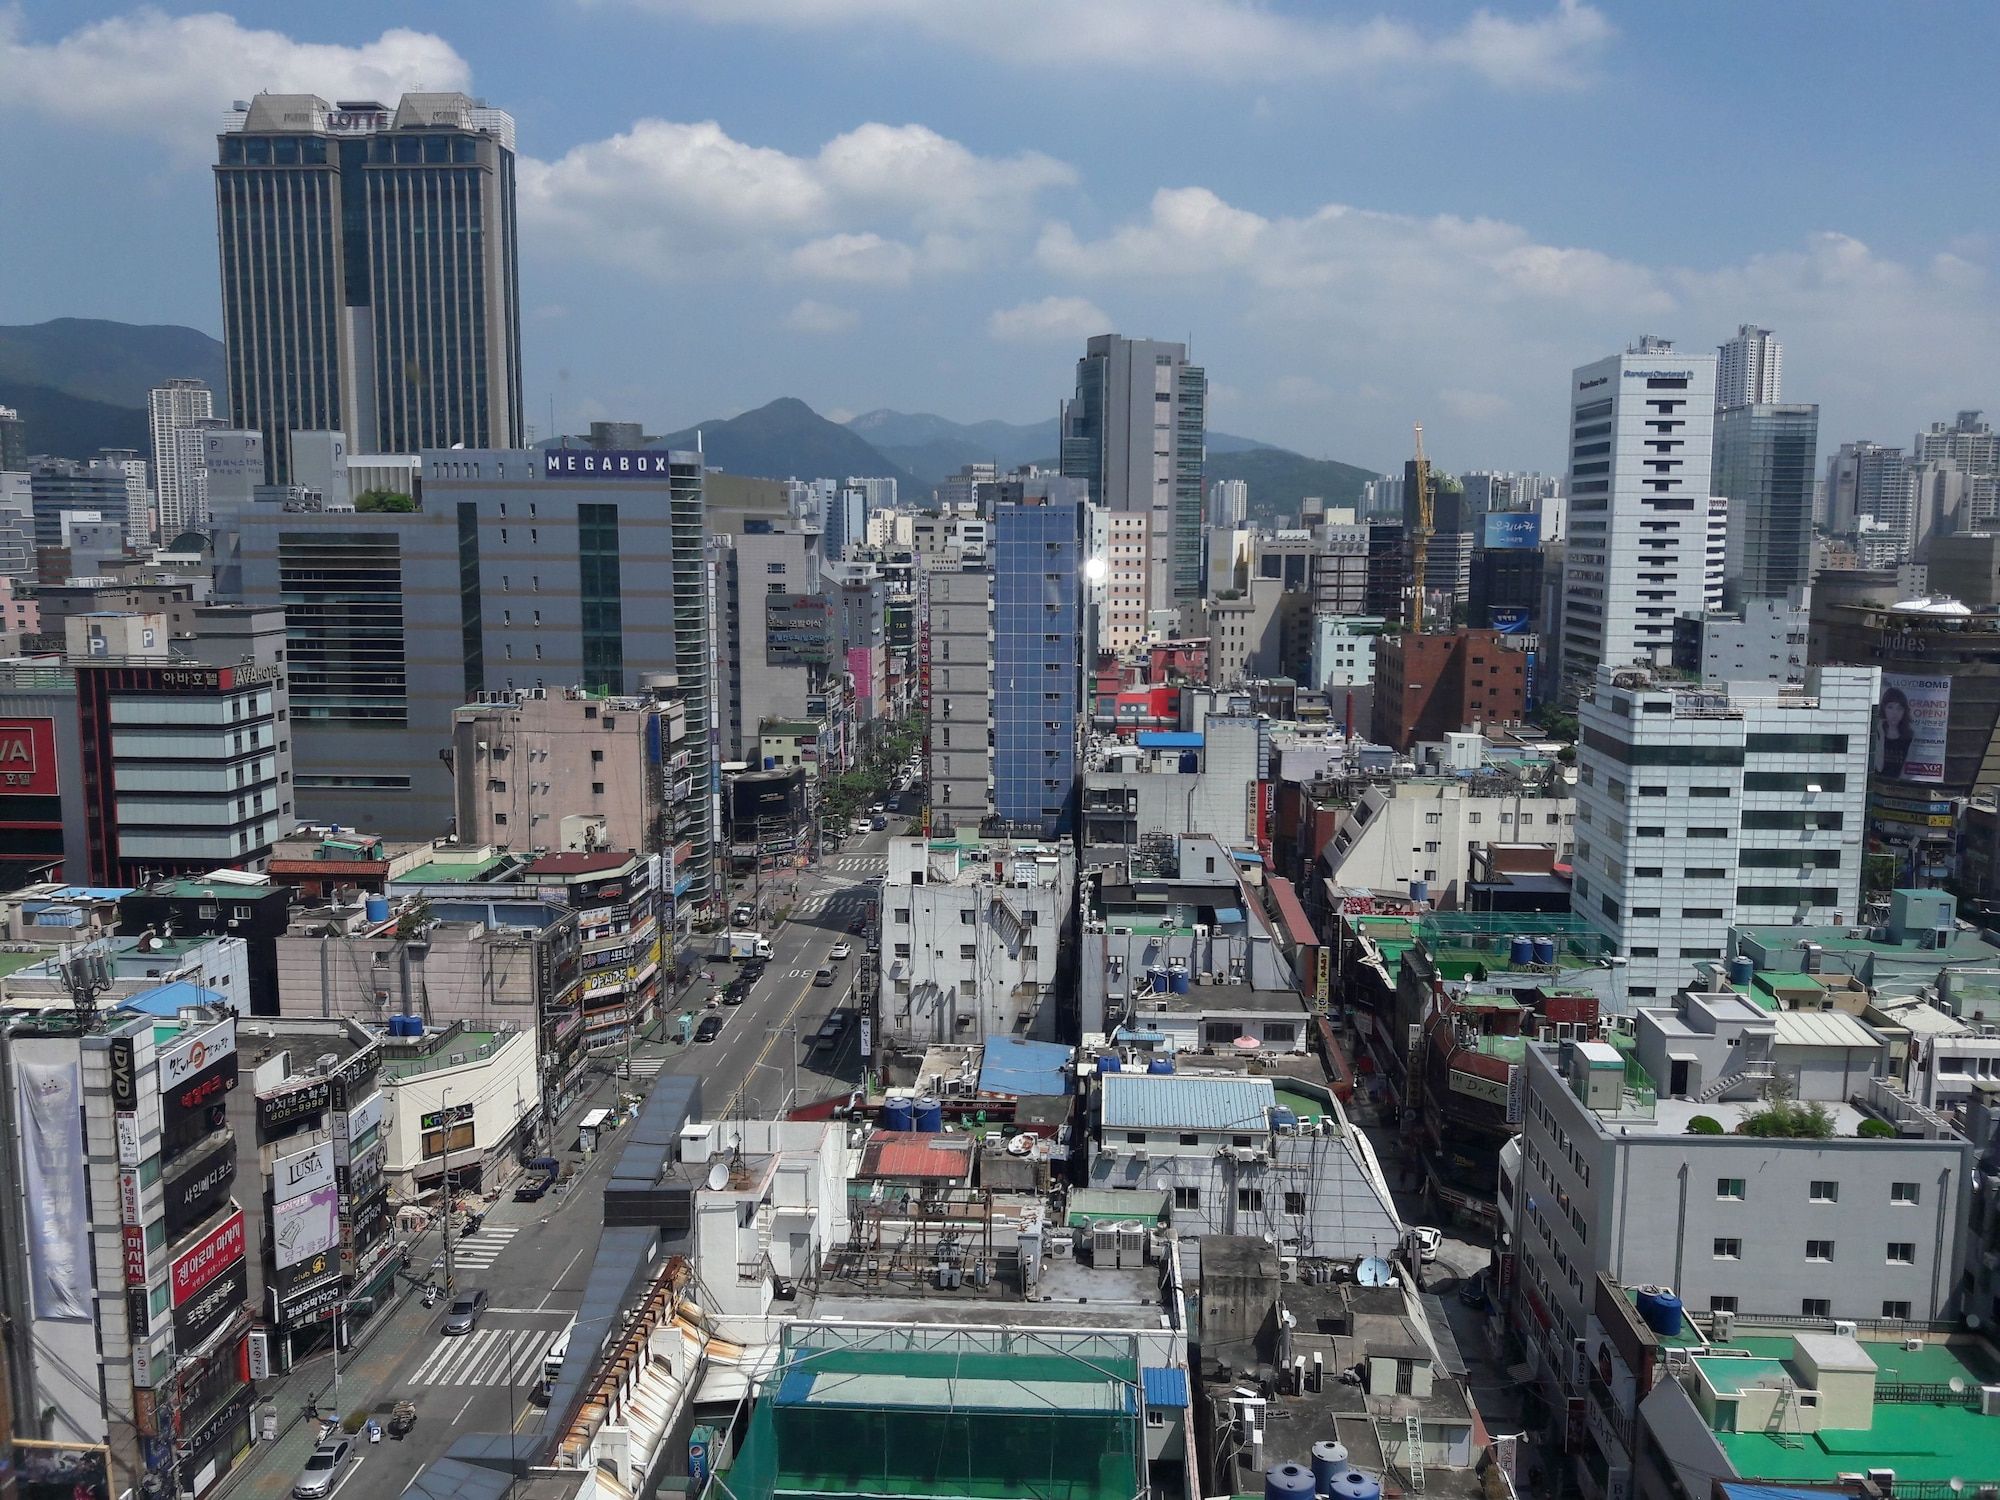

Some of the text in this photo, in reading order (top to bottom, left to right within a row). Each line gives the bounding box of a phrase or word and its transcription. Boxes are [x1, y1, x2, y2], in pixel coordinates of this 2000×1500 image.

[327, 113, 388, 130] LOTTE
[335, 443, 342, 461] P
[547, 456, 665, 471] MEGABOX
[143, 631, 153, 645] P
[90, 639, 104, 654] P
[163, 672, 217, 686] 아바호텔
[257, 665, 281, 680] HOTEL
[542, 944, 550, 985] multi bar
[271, 1098, 324, 1121] 808-9998
[286, 1158, 323, 1186] LUSIA
[189, 1244, 215, 1273] 아로마
[216, 1222, 241, 1252] 마사지
[127, 1237, 144, 1277] 마사지
[294, 1270, 311, 1283] club
[372, 1429, 380, 1439] P
